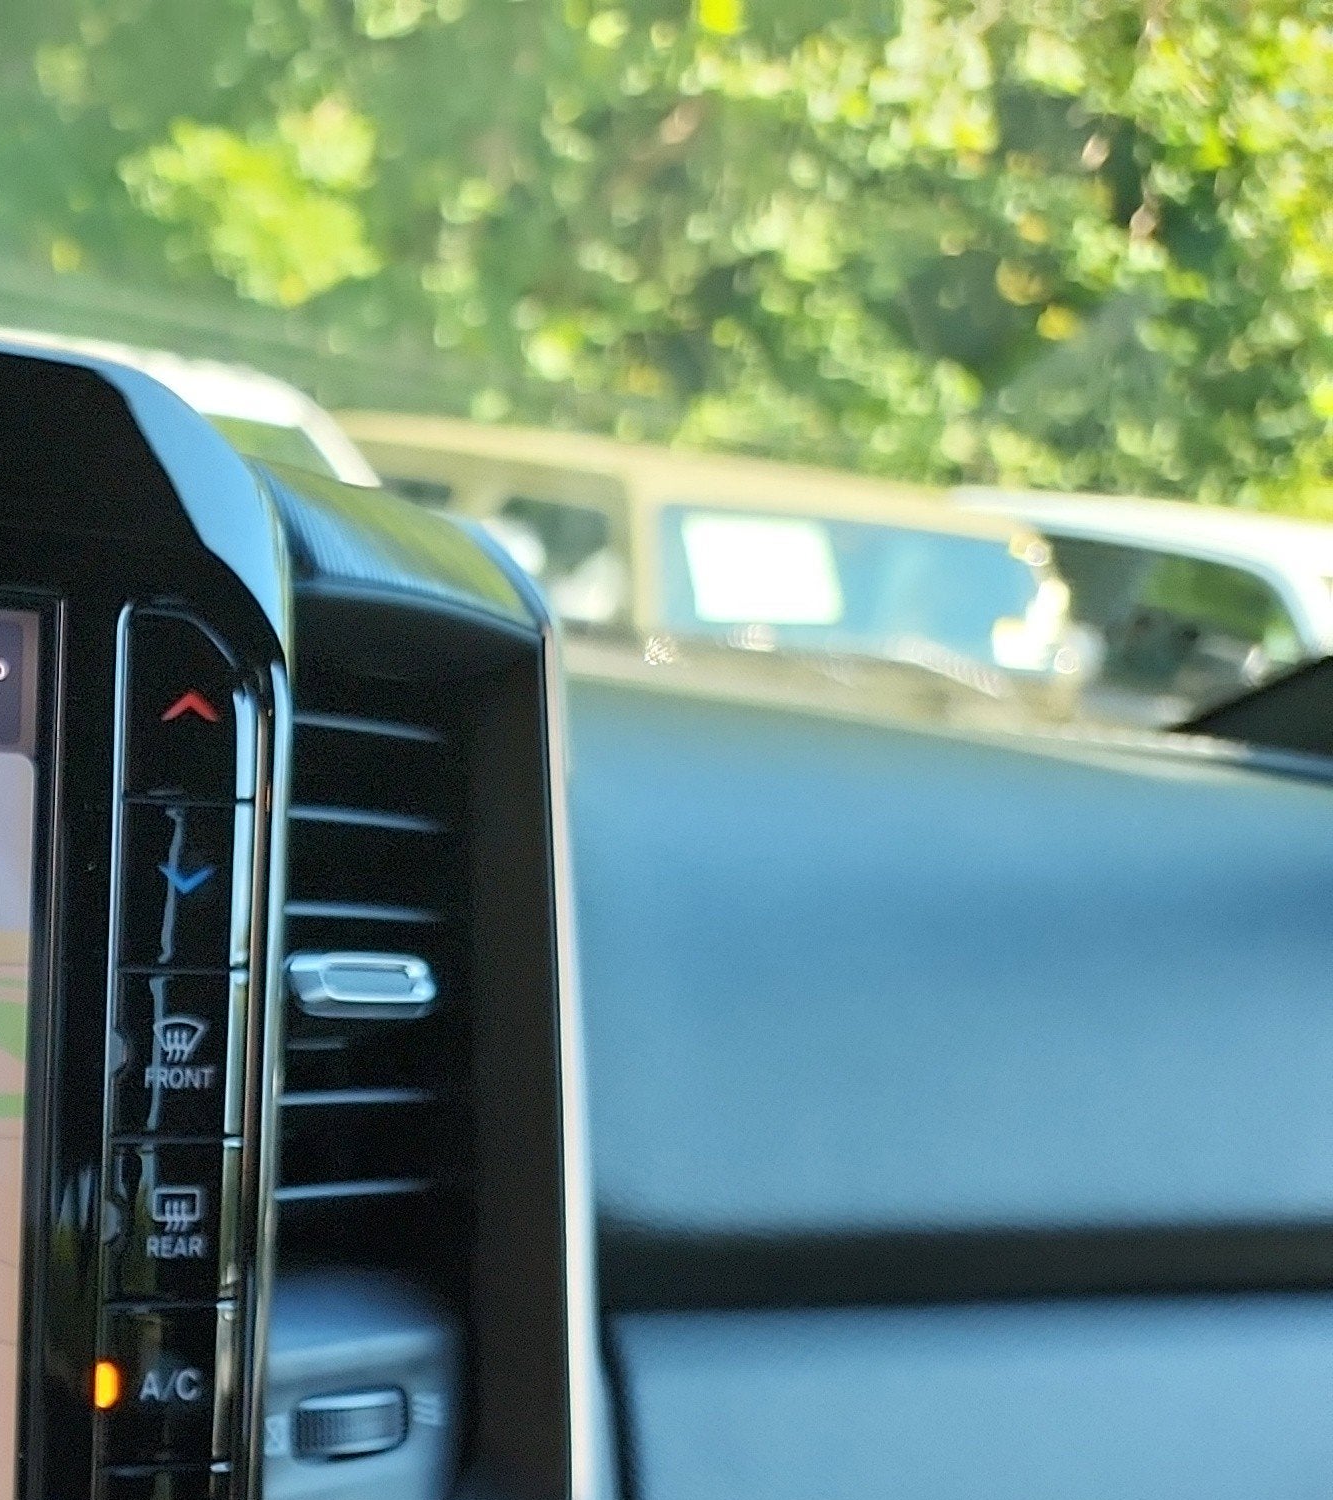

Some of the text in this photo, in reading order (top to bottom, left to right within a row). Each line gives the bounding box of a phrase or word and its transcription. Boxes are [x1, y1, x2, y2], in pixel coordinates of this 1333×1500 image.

[144, 1065, 215, 1089] FRONT
[145, 1235, 204, 1258] REAR
[140, 1373, 202, 1400] A/C
